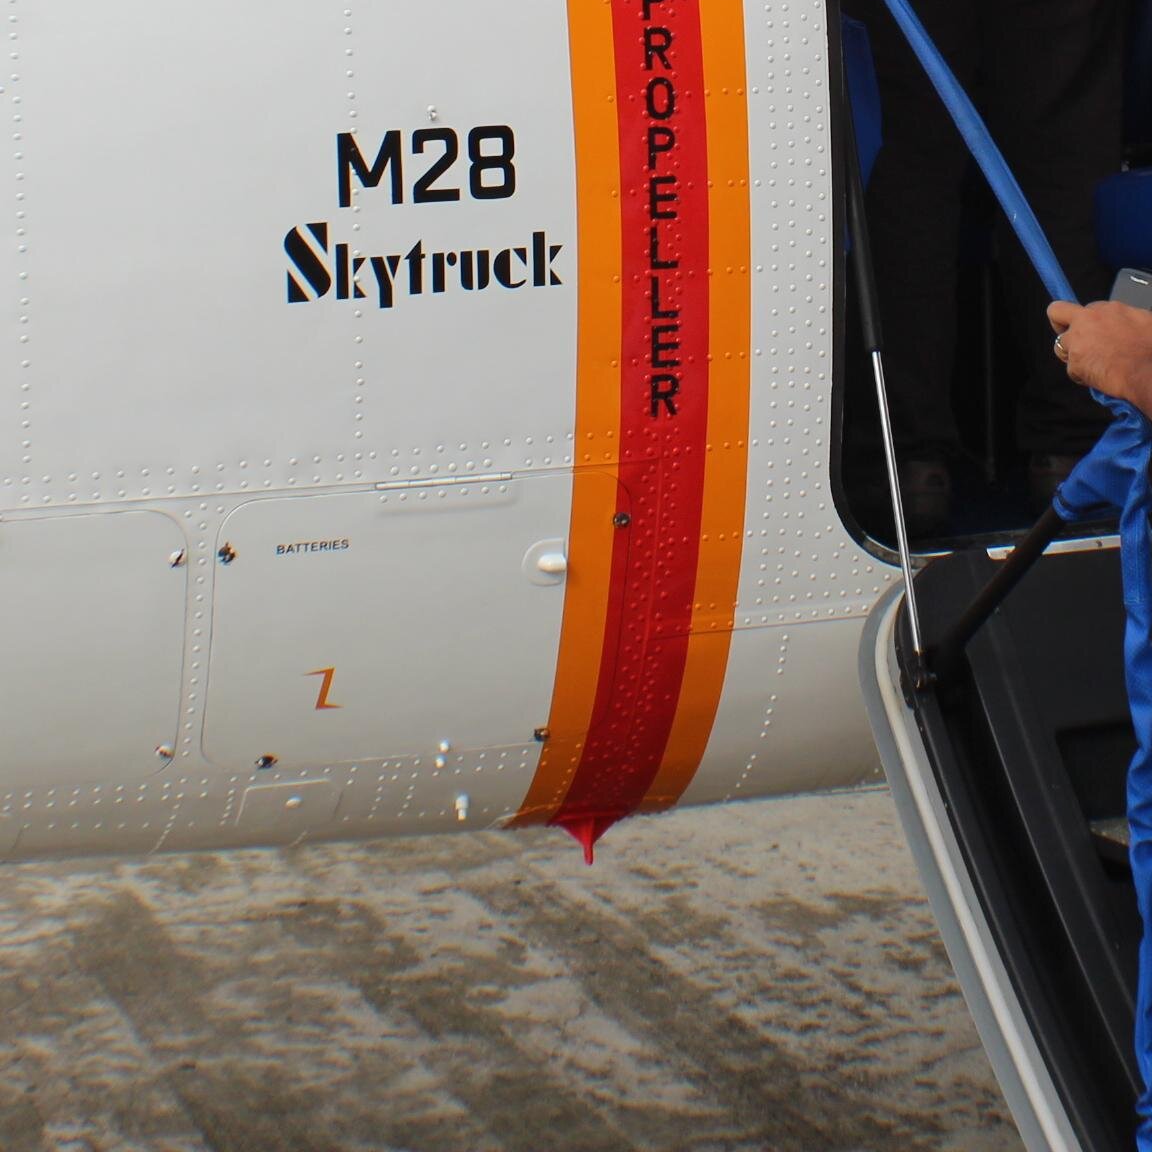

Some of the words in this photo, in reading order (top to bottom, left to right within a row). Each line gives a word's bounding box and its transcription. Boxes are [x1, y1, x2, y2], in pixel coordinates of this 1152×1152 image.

[336, 125, 517, 208] M28
[283, 222, 564, 309] Skytruck
[275, 539, 350, 556] BATTERIES
